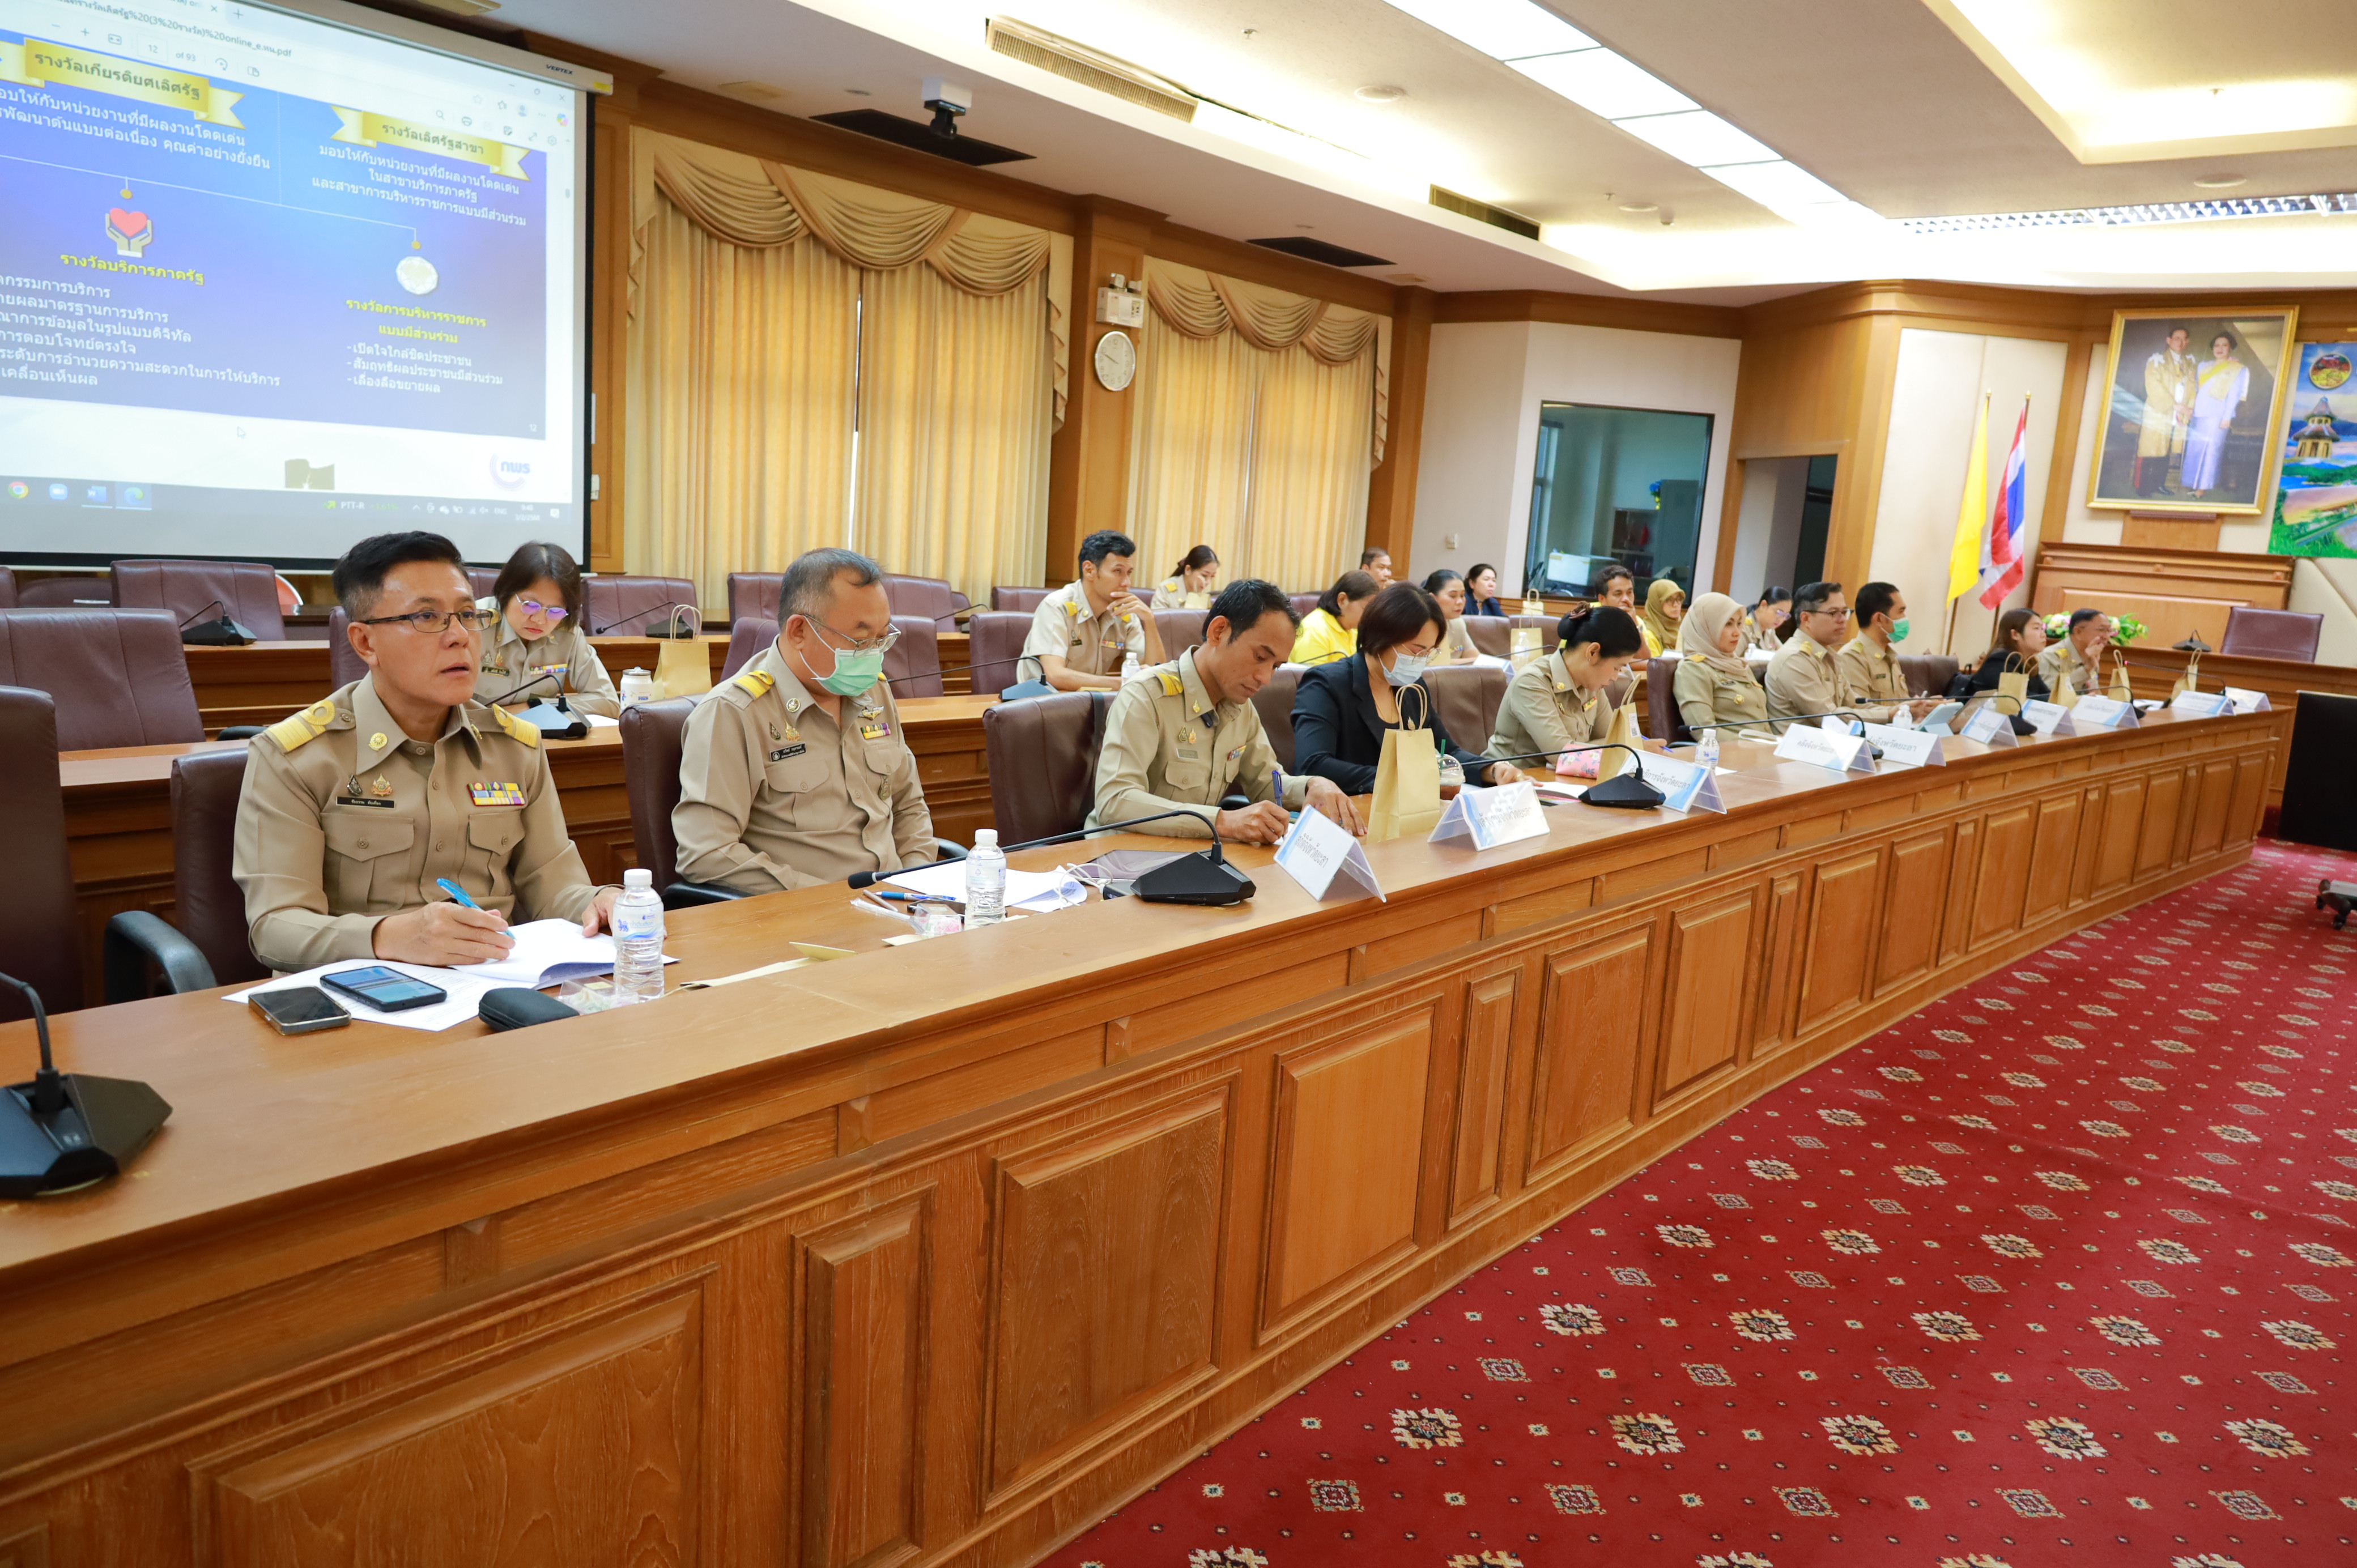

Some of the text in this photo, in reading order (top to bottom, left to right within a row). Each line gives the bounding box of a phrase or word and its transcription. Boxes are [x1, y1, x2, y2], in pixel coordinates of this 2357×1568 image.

[148, 45, 158, 53] 12
[186, 53, 196, 62] 93
[546, 64, 573, 74] VERTEX
[382, 124, 484, 154] รางวัลเลิศรัฐสาขา
[319, 145, 520, 195] มอบให้กับหน่วยงานที่มีผลงานโดดเด่น
[369, 168, 478, 203] ในสาขาบริการภาครัฐ
[60, 253, 205, 286] รางวัลบริการภาครัฐ
[346, 299, 487, 327] รางวัลการบริหารราชการ
[378, 325, 458, 343] แบบมีส่วนร่วม
[341, 501, 364, 510] PTT-R
